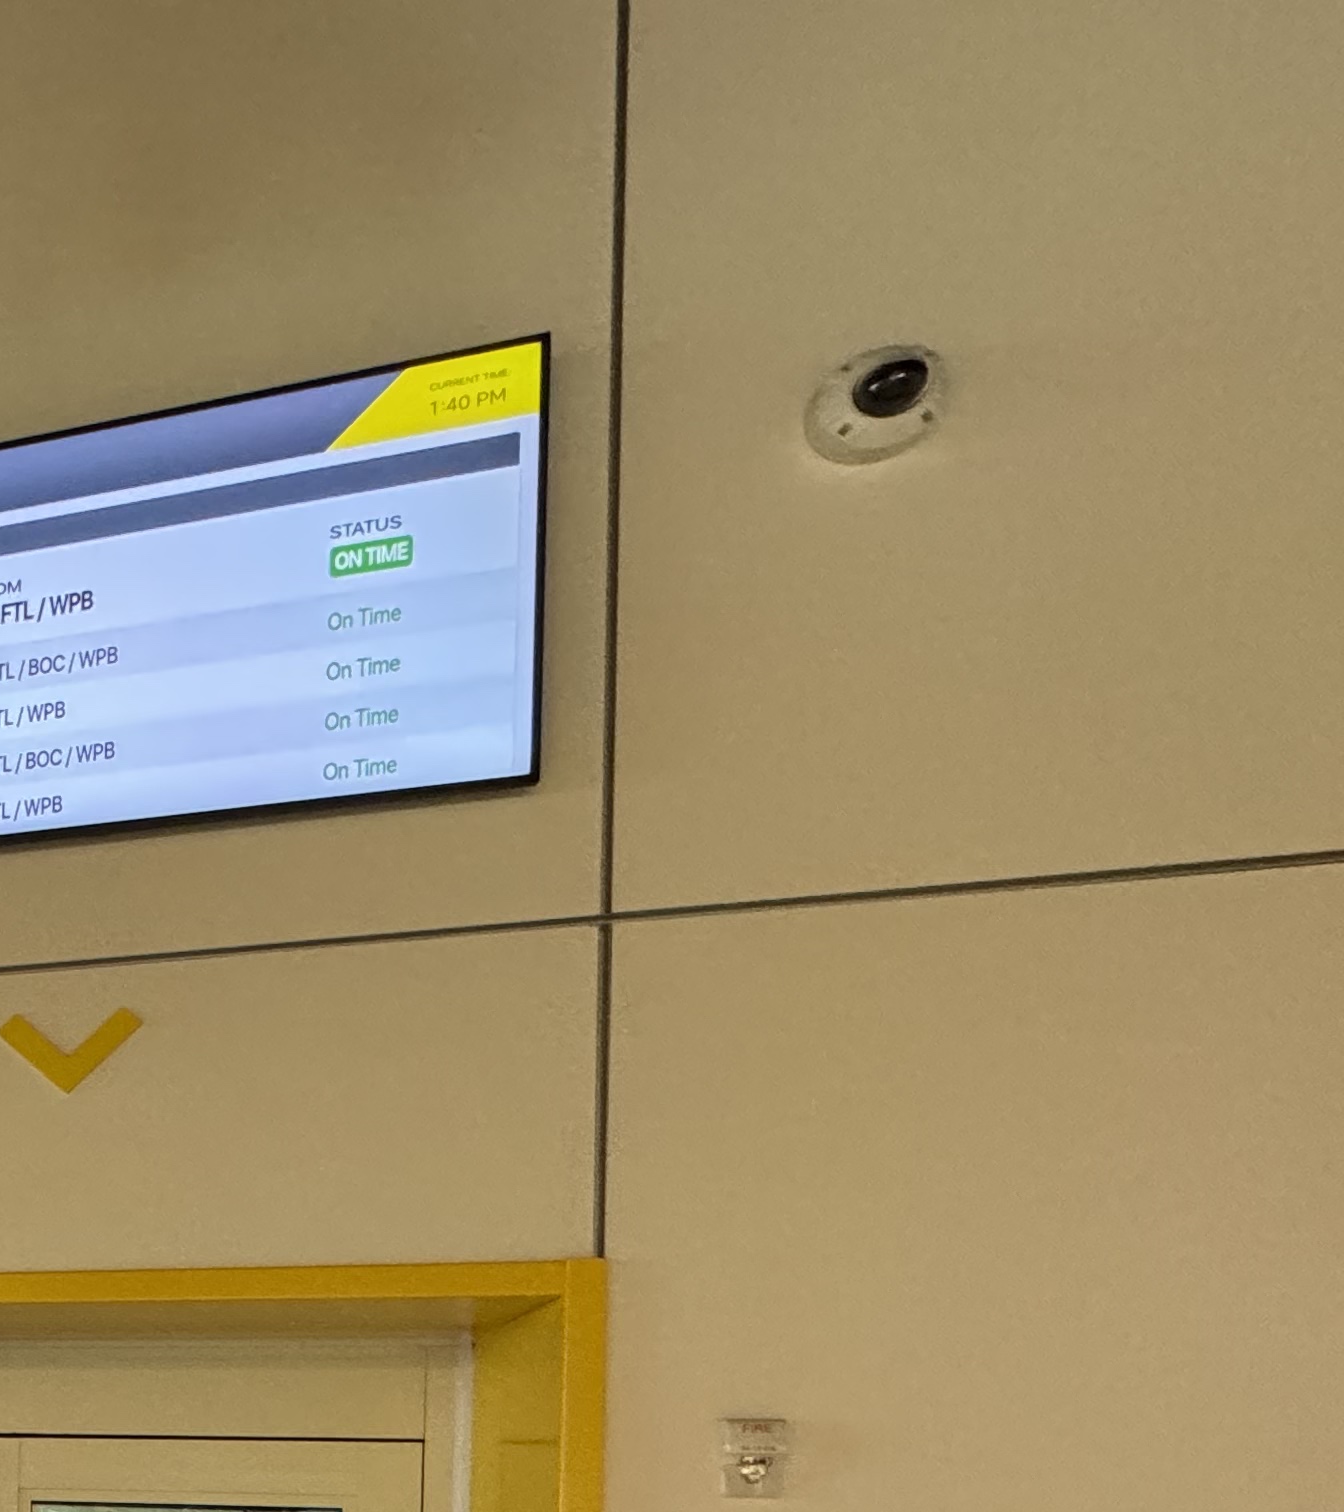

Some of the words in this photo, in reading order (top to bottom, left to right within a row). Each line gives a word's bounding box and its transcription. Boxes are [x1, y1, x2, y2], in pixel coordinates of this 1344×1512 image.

[430, 393, 471, 416] 1:40
[476, 387, 507, 406] PM
[330, 515, 402, 539] STATUS
[335, 547, 364, 571] ON
[365, 541, 409, 566] TIME
[1, 600, 34, 626] FTL
[50, 590, 93, 615] WPB
[328, 612, 353, 631] On
[358, 606, 401, 627] Time
[28, 654, 65, 676] BOC
[79, 646, 118, 669] WPB
[326, 662, 352, 681] On
[357, 656, 401, 677] Time
[27, 700, 65, 722] WPB
[325, 712, 350, 731] On
[356, 707, 399, 727] Time
[26, 747, 62, 769] BOC
[76, 741, 115, 763] WPB
[323, 763, 348, 781] On
[354, 758, 397, 777] Time
[25, 795, 63, 816] WPB
